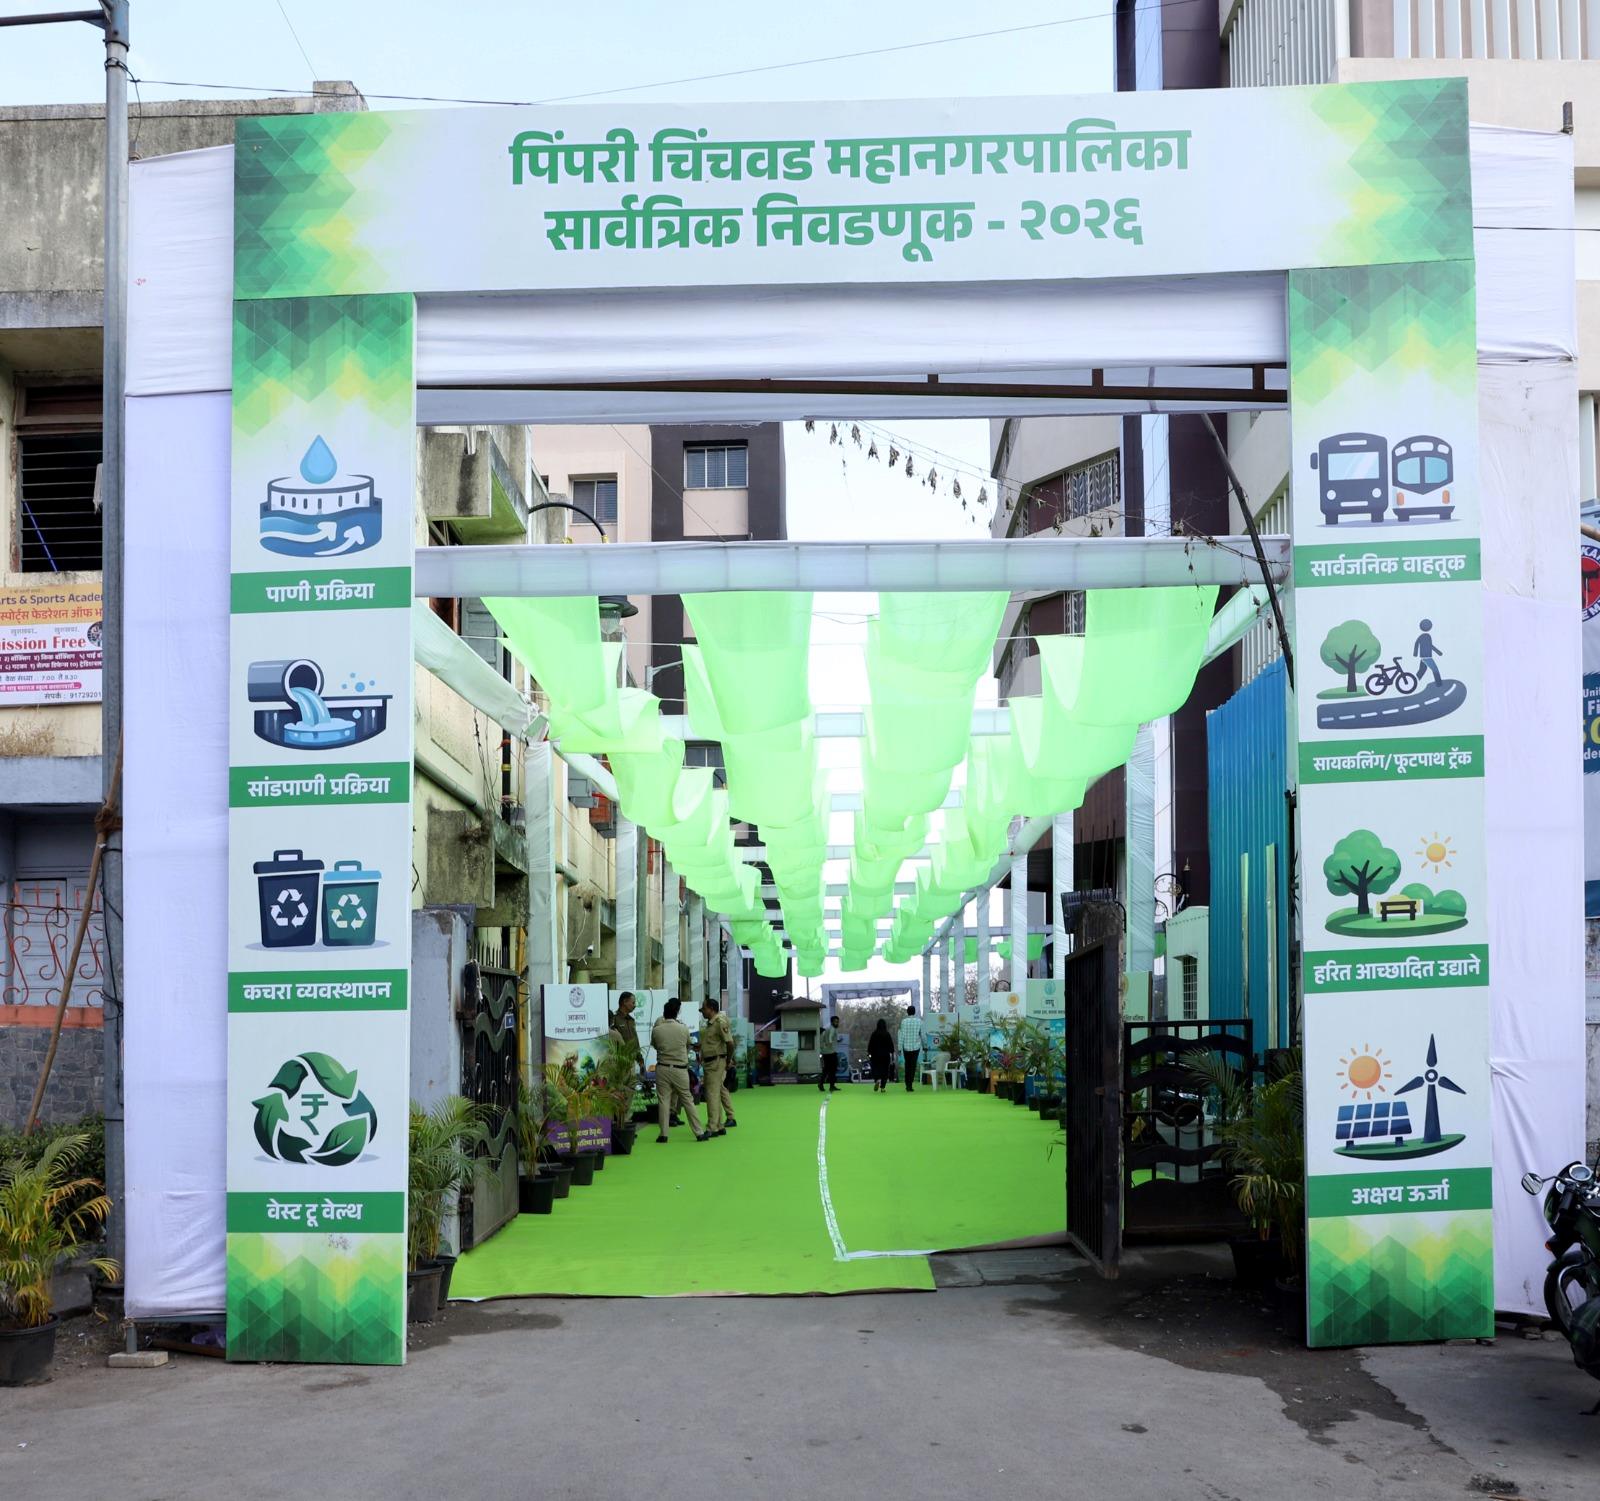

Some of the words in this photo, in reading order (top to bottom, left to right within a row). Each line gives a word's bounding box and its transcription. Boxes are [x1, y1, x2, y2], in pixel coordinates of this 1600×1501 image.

[508, 128, 639, 185] पिंपरी
[648, 128, 815, 182] चिंचवड
[824, 118, 1192, 184] महानगरपालिका
[544, 194, 743, 250] सार्वत्रिक
[752, 192, 975, 262] निवडणूक
[987, 220, 1005, 230] -
[1020, 198, 1144, 245] २०२६
[1310, 553, 1399, 577] सार्वजनिक
[1402, 554, 1467, 579] वाहतूक
[1581, 545, 1600, 562] KA
[20, 595, 28, 604] &
[31, 594, 66, 606] Sports
[265, 580, 312, 603] पाणी
[314, 579, 375, 603] प्रक्रिया
[32, 607, 68, 619] फेडरेशन
[71, 606, 92, 618] ऑफ
[0, 637, 47, 650] ission
[53, 635, 87, 648] Free
[1313, 750, 1445, 774] सायकलिंग/फूटपाथ
[1448, 747, 1473, 770] ट्रॅक
[247, 774, 327, 798] सांडपाणी
[330, 773, 391, 797] प्रक्रिया
[1313, 959, 1353, 985] हरित
[1356, 956, 1435, 980] आच्छादित
[1438, 953, 1481, 978] उद्याने
[243, 983, 292, 1000] कचरा
[296, 982, 392, 1001] व्यवस्थापन
[1351, 1186, 1404, 1206] अक्षय
[1407, 1179, 1450, 1202] ऊर्जा
[266, 1198, 302, 1222] वेस्ट
[306, 1203, 319, 1227] टू
[322, 1199, 363, 1221] वेल्थ
